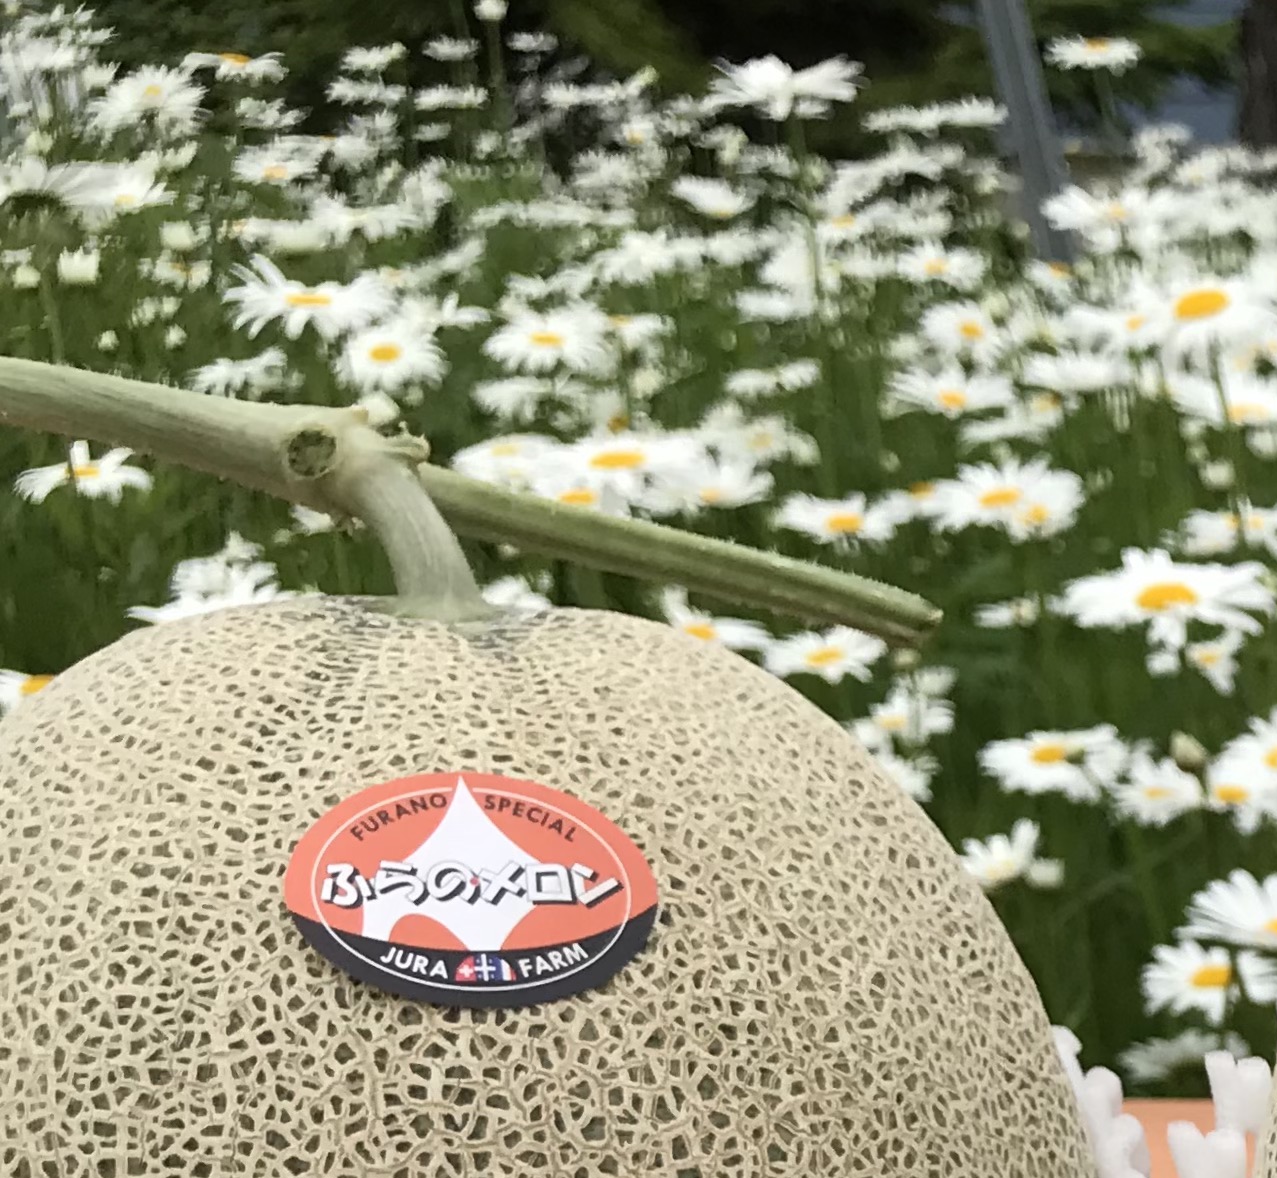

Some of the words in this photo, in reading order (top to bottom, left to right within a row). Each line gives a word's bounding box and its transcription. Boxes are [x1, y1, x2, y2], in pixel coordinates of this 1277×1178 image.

[350, 792, 448, 842] FURANO
[484, 794, 577, 842] SPECIAL
[320, 859, 624, 908] ふらのメロン
[379, 946, 449, 979] JURA
[518, 942, 589, 978] FARM
